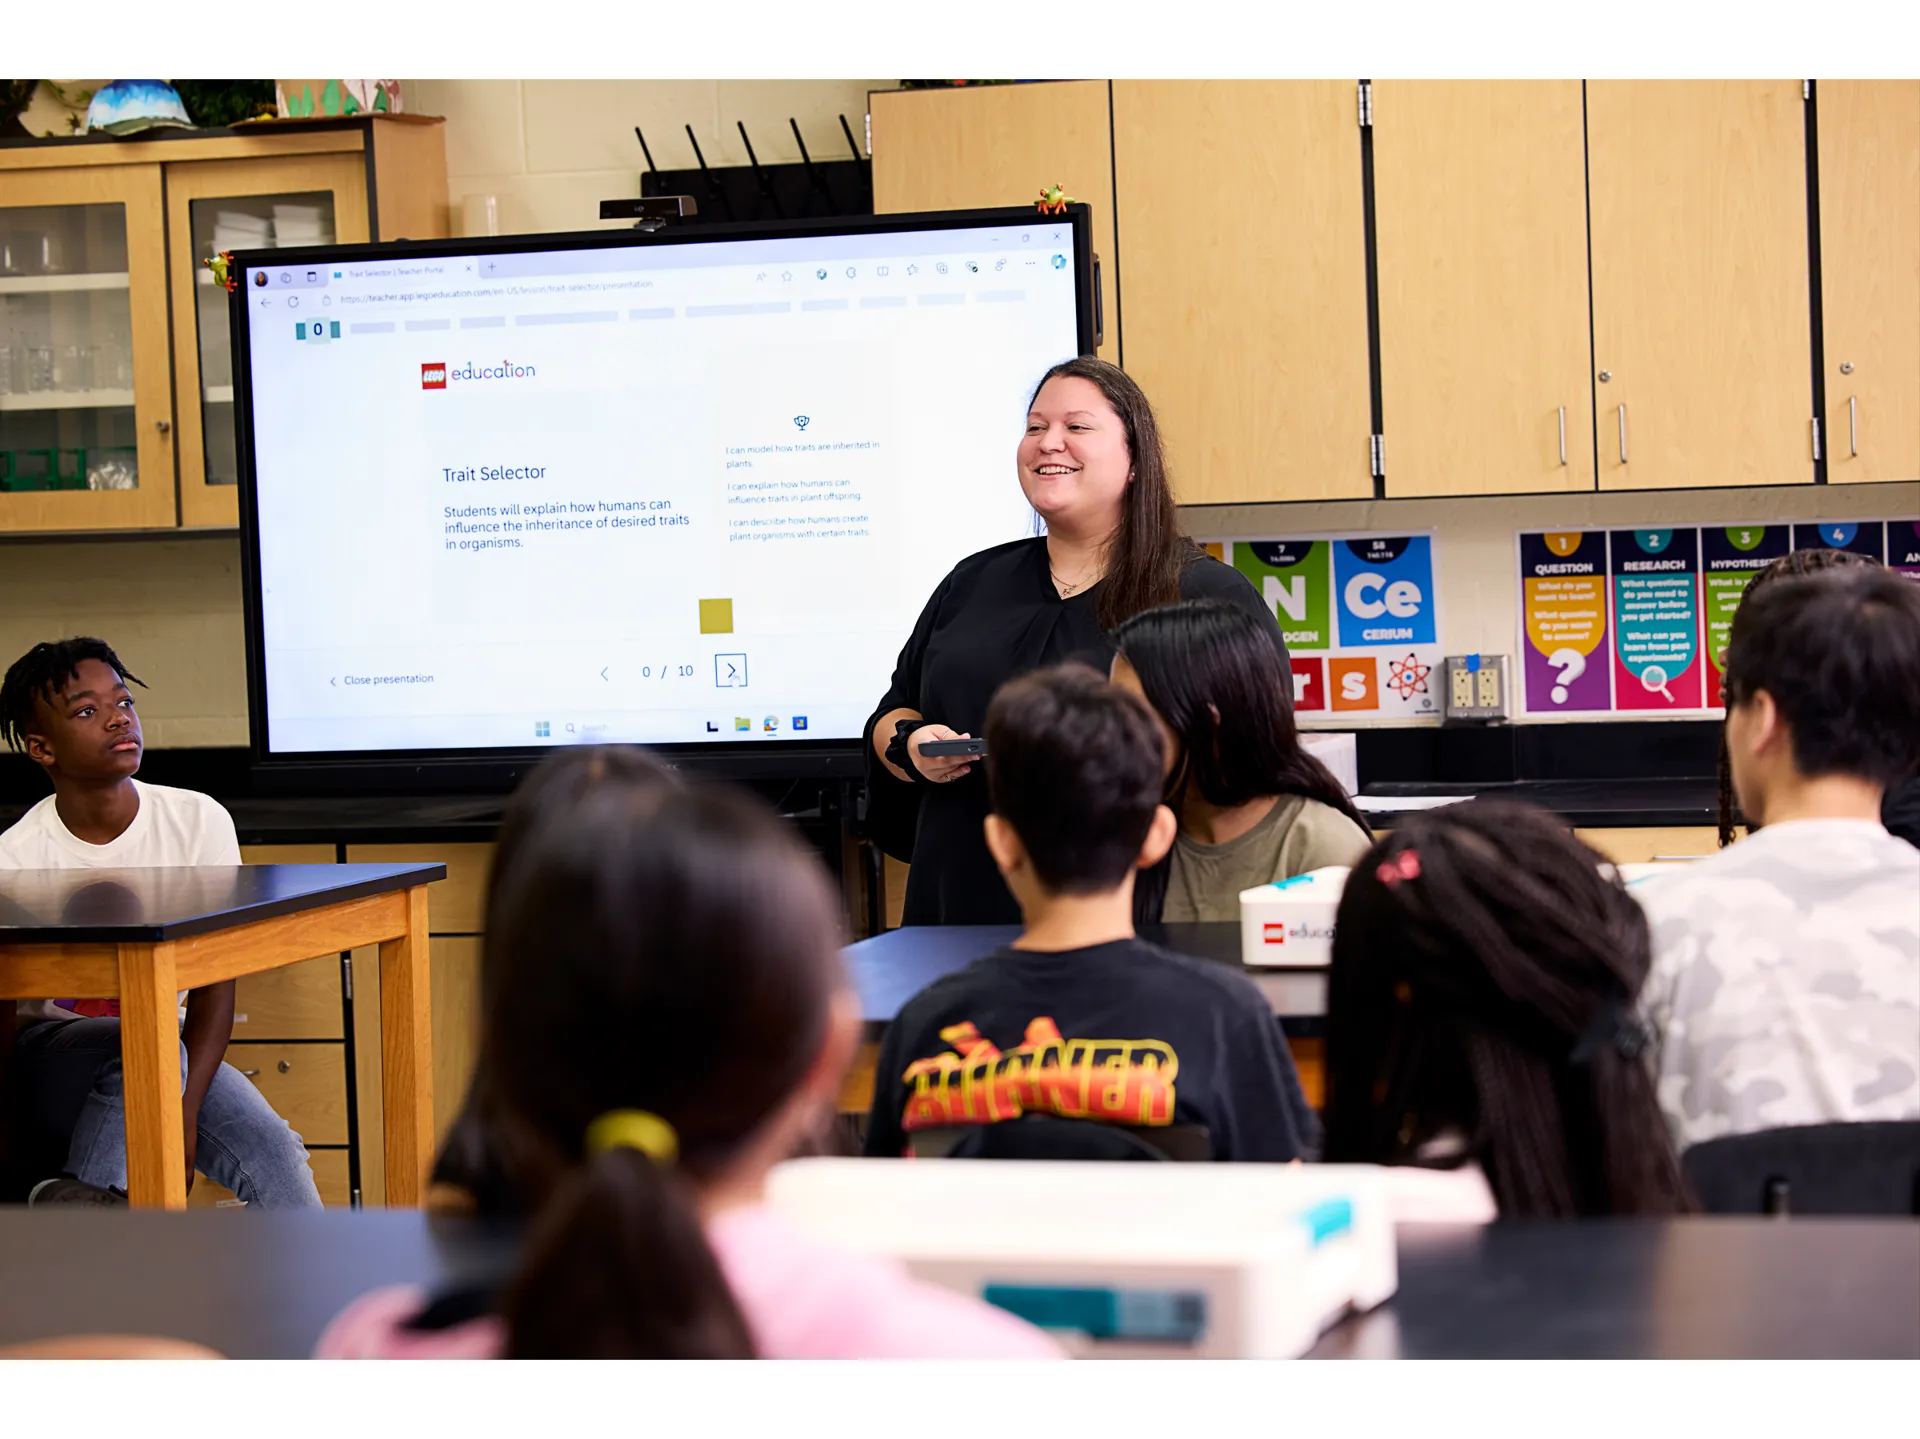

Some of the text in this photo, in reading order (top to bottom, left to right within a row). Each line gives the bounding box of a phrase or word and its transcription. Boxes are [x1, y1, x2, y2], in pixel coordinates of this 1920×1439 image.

[349, 270, 363, 278] Trait
[365, 268, 392, 278] Selector
[398, 266, 422, 276] Teacher
[424, 266, 444, 274] Portal
[314, 322, 322, 336] 0
[451, 360, 536, 380] education
[748, 444, 774, 454] model
[776, 444, 793, 452] how
[796, 442, 816, 452] traits
[833, 441, 870, 450] inherited
[872, 440, 880, 448] in
[443, 465, 546, 482] Trait Selector
[749, 480, 778, 492] explain
[781, 480, 798, 488] how
[800, 479, 833, 488] humans
[728, 496, 766, 504] influence
[768, 494, 789, 502] traits
[791, 494, 798, 502] in
[800, 492, 822, 503] plant
[444, 500, 671, 518] Students will explain how humans can
[445, 514, 690, 534] influence the inheritance of desired traits
[750, 516, 786, 526] describe
[788, 516, 806, 524] how
[808, 514, 840, 524] humans
[843, 514, 868, 522] create
[730, 532, 752, 542] plant
[753, 531, 795, 542] organisms
[798, 530, 815, 539] with
[817, 528, 846, 538] certain
[1648, 534, 1660, 547] 2
[1741, 532, 1751, 544] 3
[1832, 528, 1844, 541] 4
[446, 536, 524, 552] in organisms.
[1278, 544, 1286, 554] 7
[1372, 540, 1386, 550] 58
[1560, 538, 1567, 550] 1
[1534, 563, 1594, 576] QUESTION
[1624, 560, 1686, 572] RESEARCH
[1621, 578, 1690, 588] What questions
[1262, 575, 1306, 621] N
[1344, 572, 1422, 619] Ce
[1624, 590, 1636, 598] do
[1637, 591, 1653, 600] you
[1678, 590, 1688, 598] to
[1658, 600, 1688, 609] before
[1621, 614, 1638, 622] you
[1282, 631, 1319, 642] OGEN
[1362, 627, 1414, 641] CERIUM
[1627, 632, 1652, 640] What
[1670, 632, 1687, 641] you
[642, 666, 650, 678] 0
[678, 664, 694, 676] 10
[344, 674, 434, 686] Close presentation
[1289, 922, 1336, 940] educa
